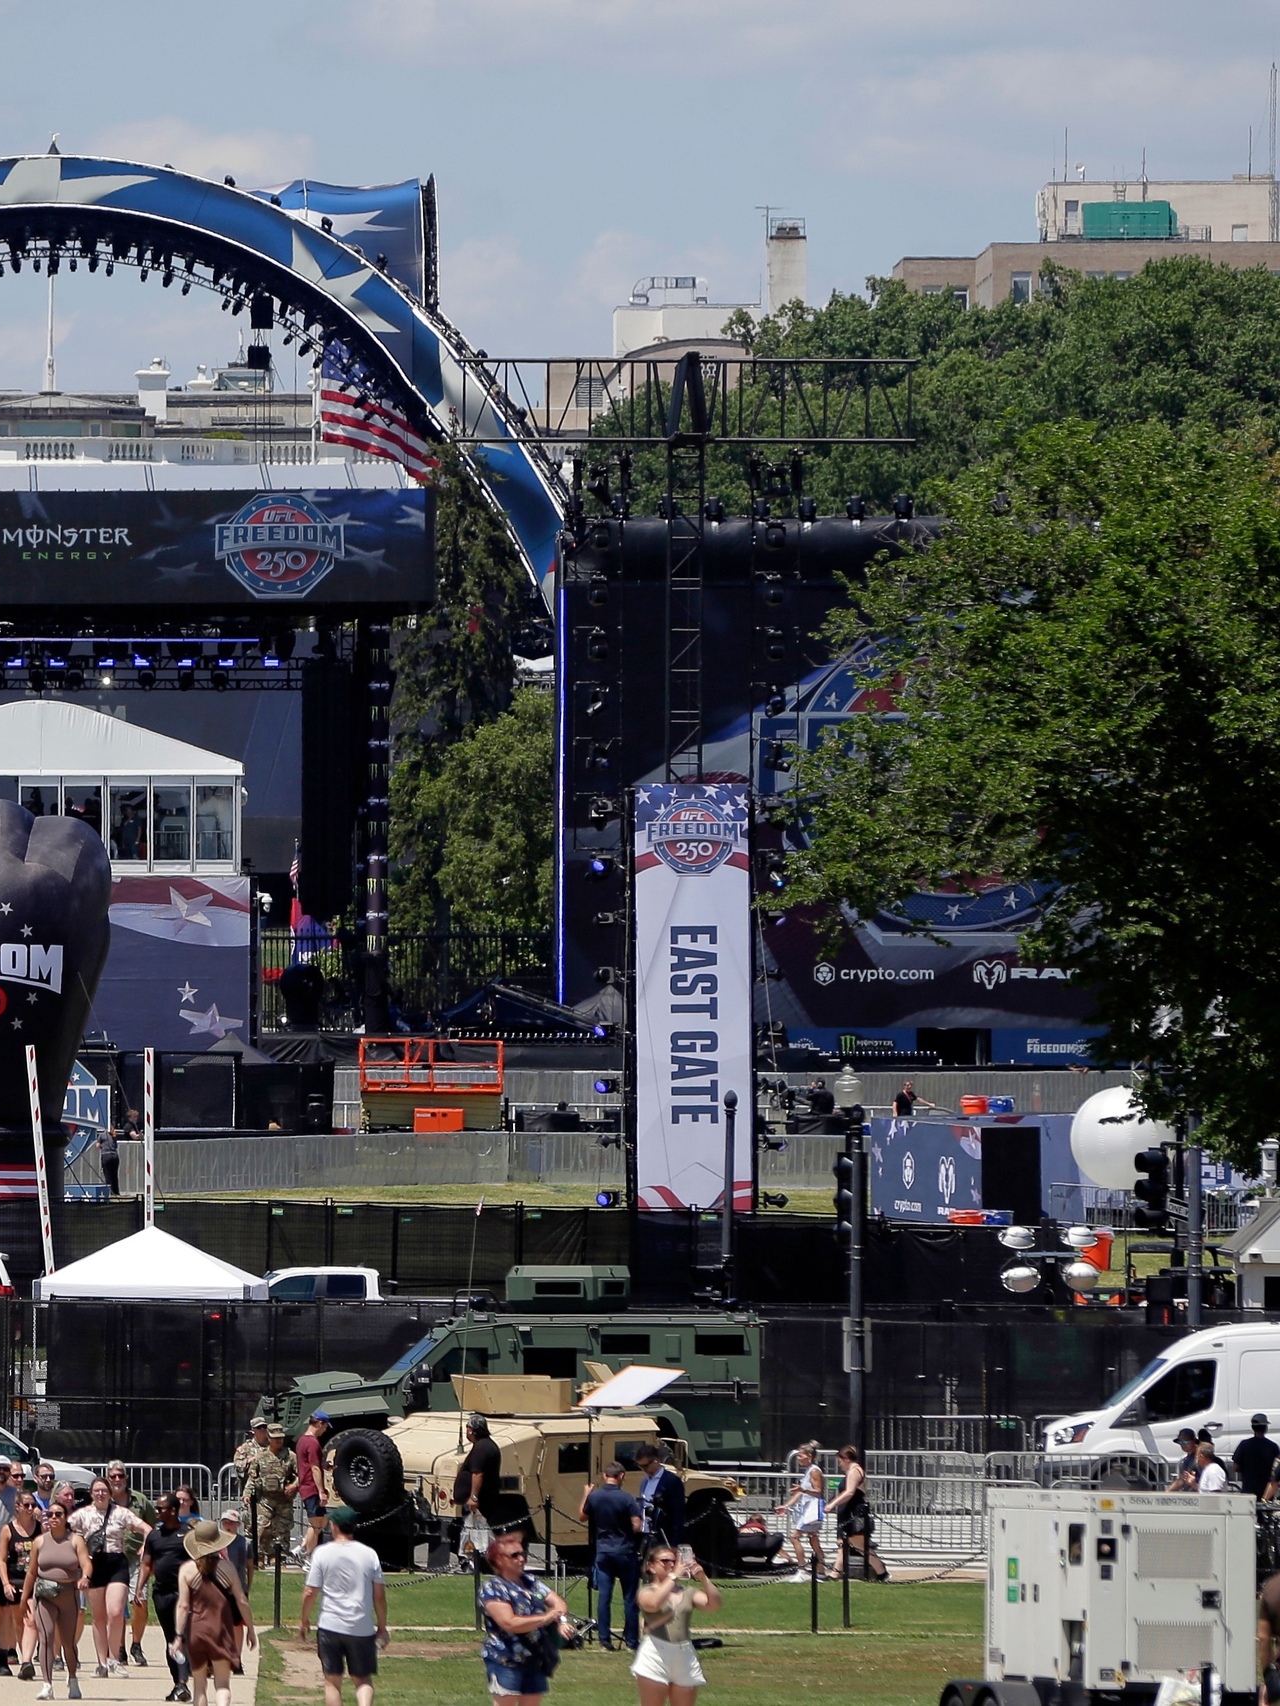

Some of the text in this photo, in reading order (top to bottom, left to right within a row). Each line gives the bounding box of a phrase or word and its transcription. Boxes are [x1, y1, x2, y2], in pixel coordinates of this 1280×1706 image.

[263, 510, 297, 522] UFC
[2, 525, 132, 548] MONSTER
[217, 524, 342, 552] FREEDOM
[22, 552, 112, 560] ENERGY
[255, 551, 307, 577] 250
[680, 812, 705, 820] UFC
[647, 823, 739, 842] FREEDOM
[675, 842, 713, 861] 250
[840, 967, 935, 982] crypto.com
[670, 926, 719, 1124] EAST GATE
